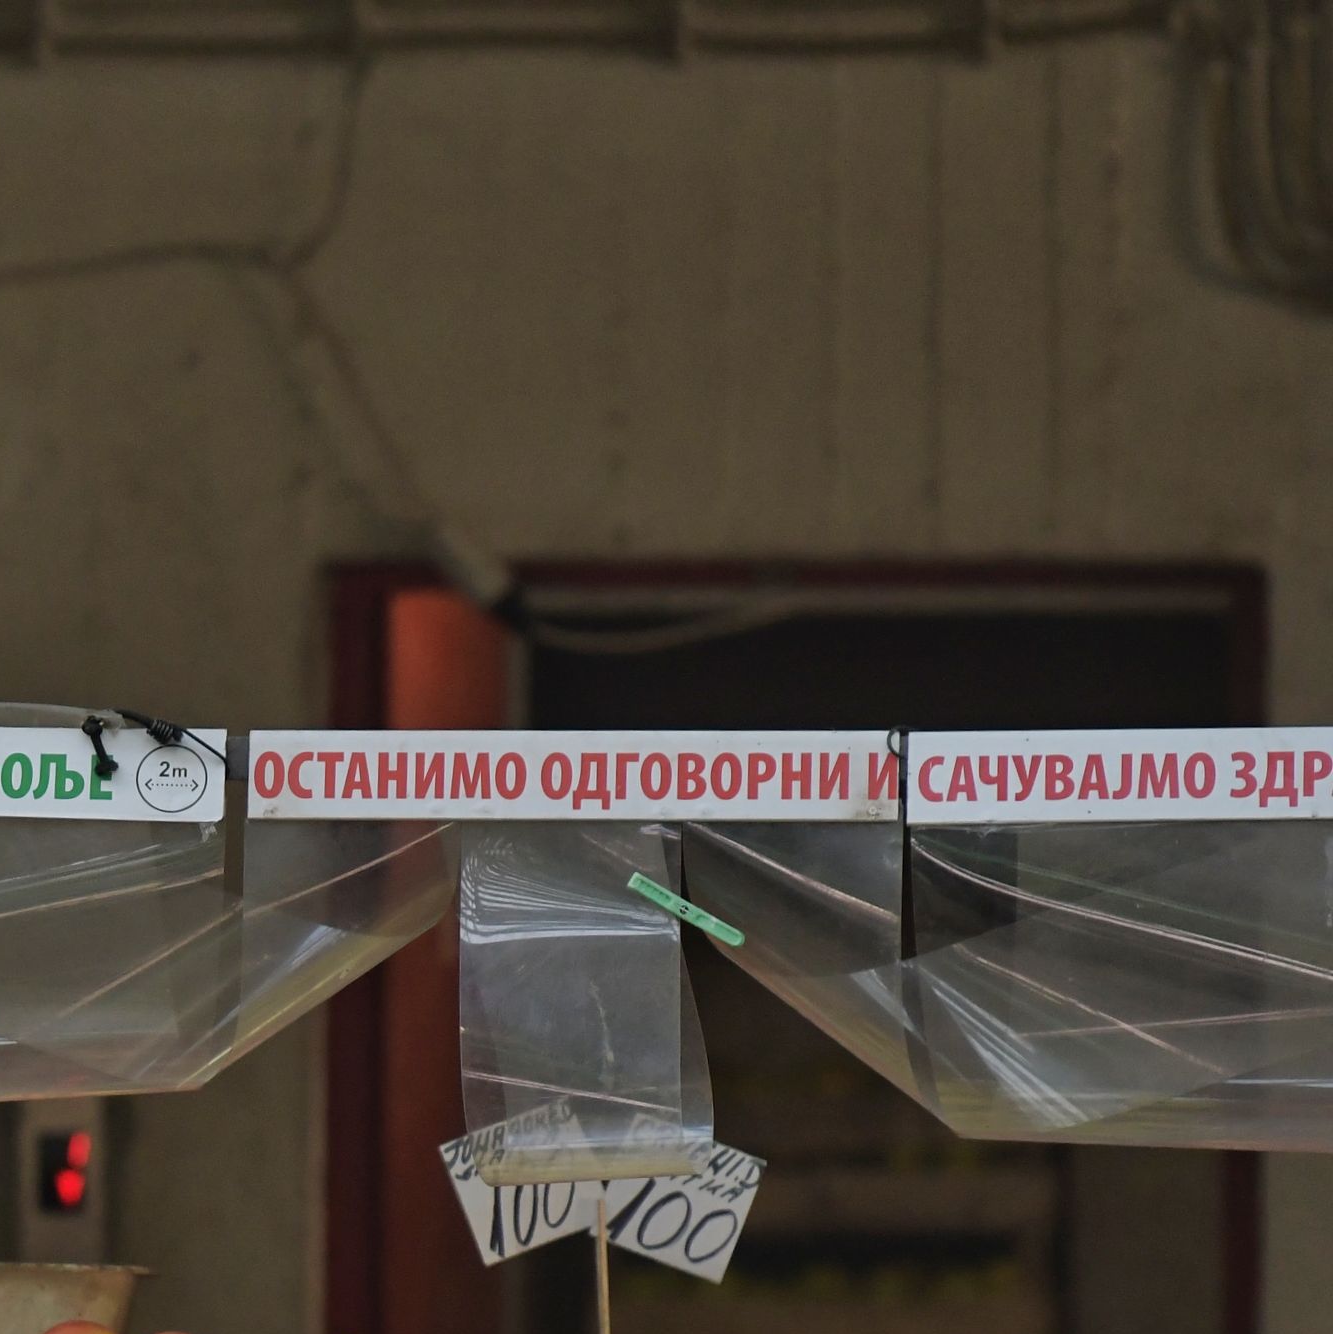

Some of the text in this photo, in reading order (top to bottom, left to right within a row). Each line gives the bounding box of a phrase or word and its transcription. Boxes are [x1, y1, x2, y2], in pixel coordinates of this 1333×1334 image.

[159, 760, 188, 779] 2m
[253, 751, 898, 810] ОСТАНИМО ОДГОВОРНИ И
[918, 751, 1333, 807] САЧУВАЈМО ЗДР
[490, 1181, 575, 1258] 100
[607, 1178, 739, 1264] 100
